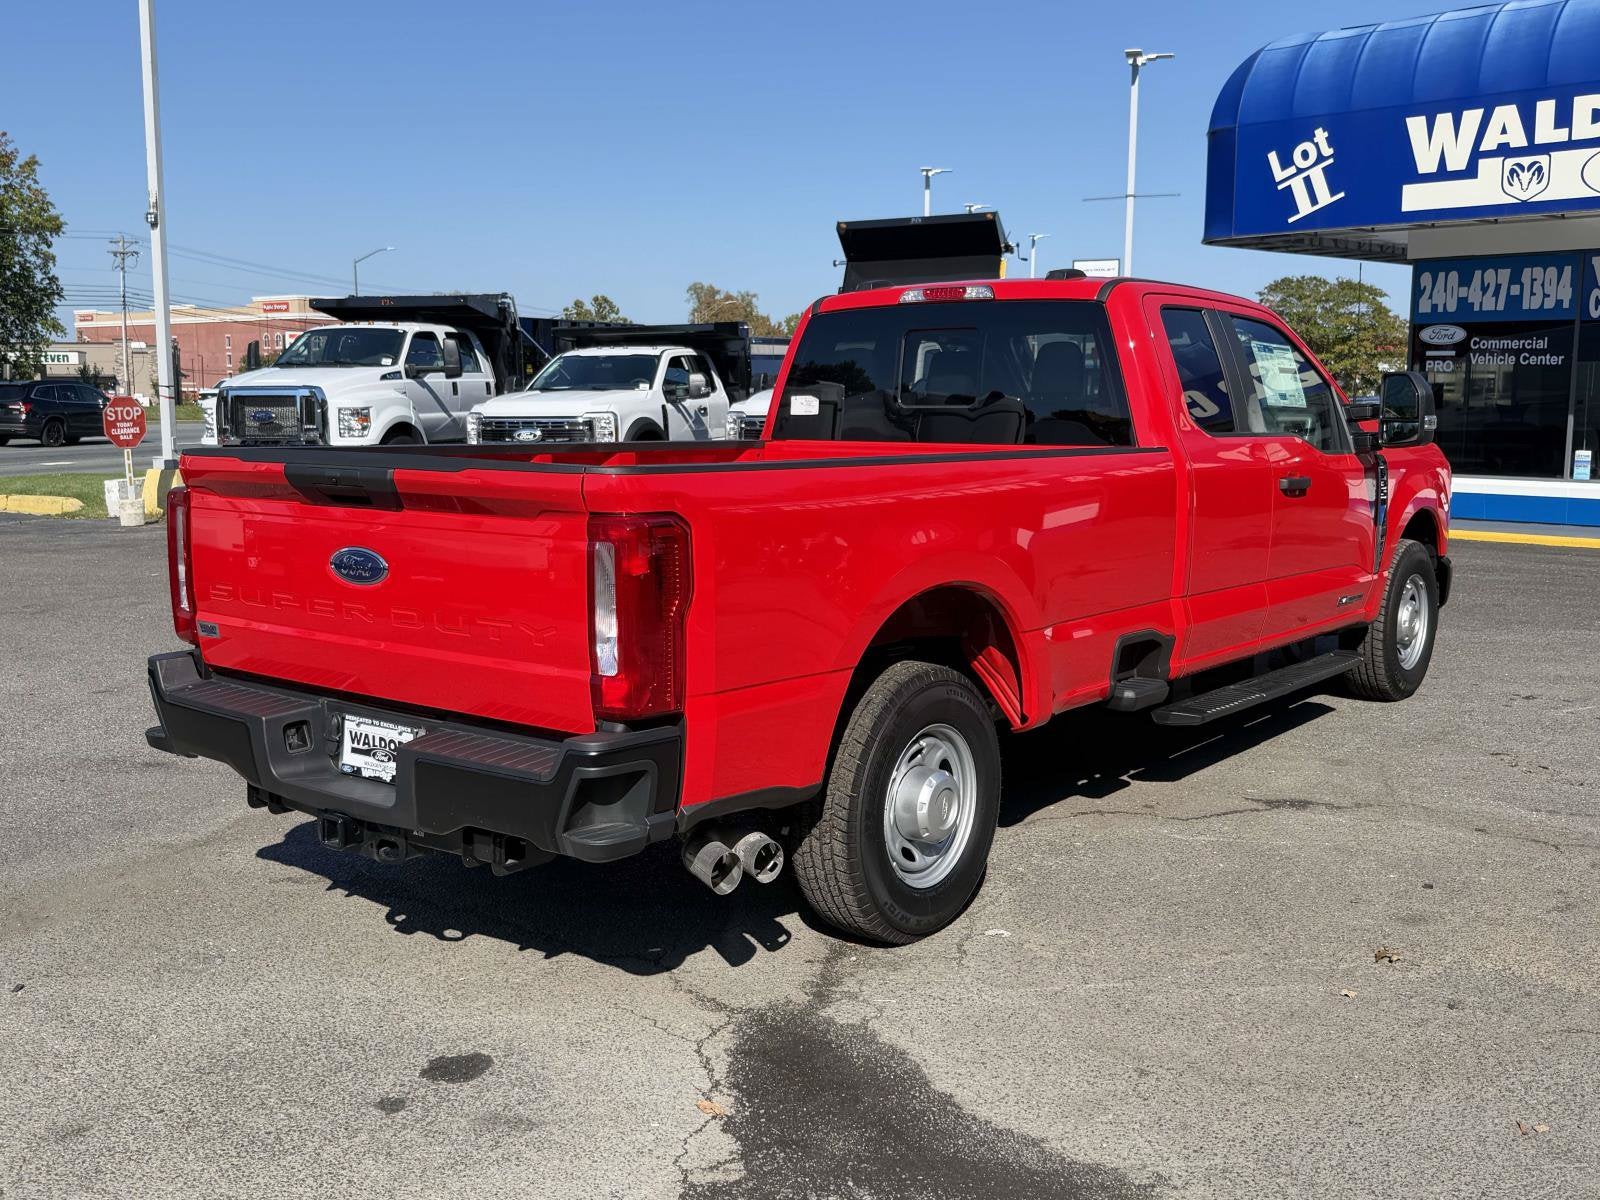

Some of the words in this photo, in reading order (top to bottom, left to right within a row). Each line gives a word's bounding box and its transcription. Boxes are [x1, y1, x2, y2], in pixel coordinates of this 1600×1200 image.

[1267, 127, 1334, 182] Lot
[1418, 265, 1572, 314] 240-427-1394
[1470, 337, 1548, 350] Commercial
[1425, 360, 1454, 372] PRO
[1470, 352, 1516, 365] Vehicle
[1519, 352, 1565, 365] Center
[106, 406, 142, 421] STOP
[111, 427, 141, 435] CLEARANCE
[209, 585, 374, 623] SUPER
[391, 606, 558, 647] DUTY
[345, 714, 372, 725] DEDICATED
[380, 721, 412, 733] EXCELLENCE
[349, 730, 403, 752] WALDO
